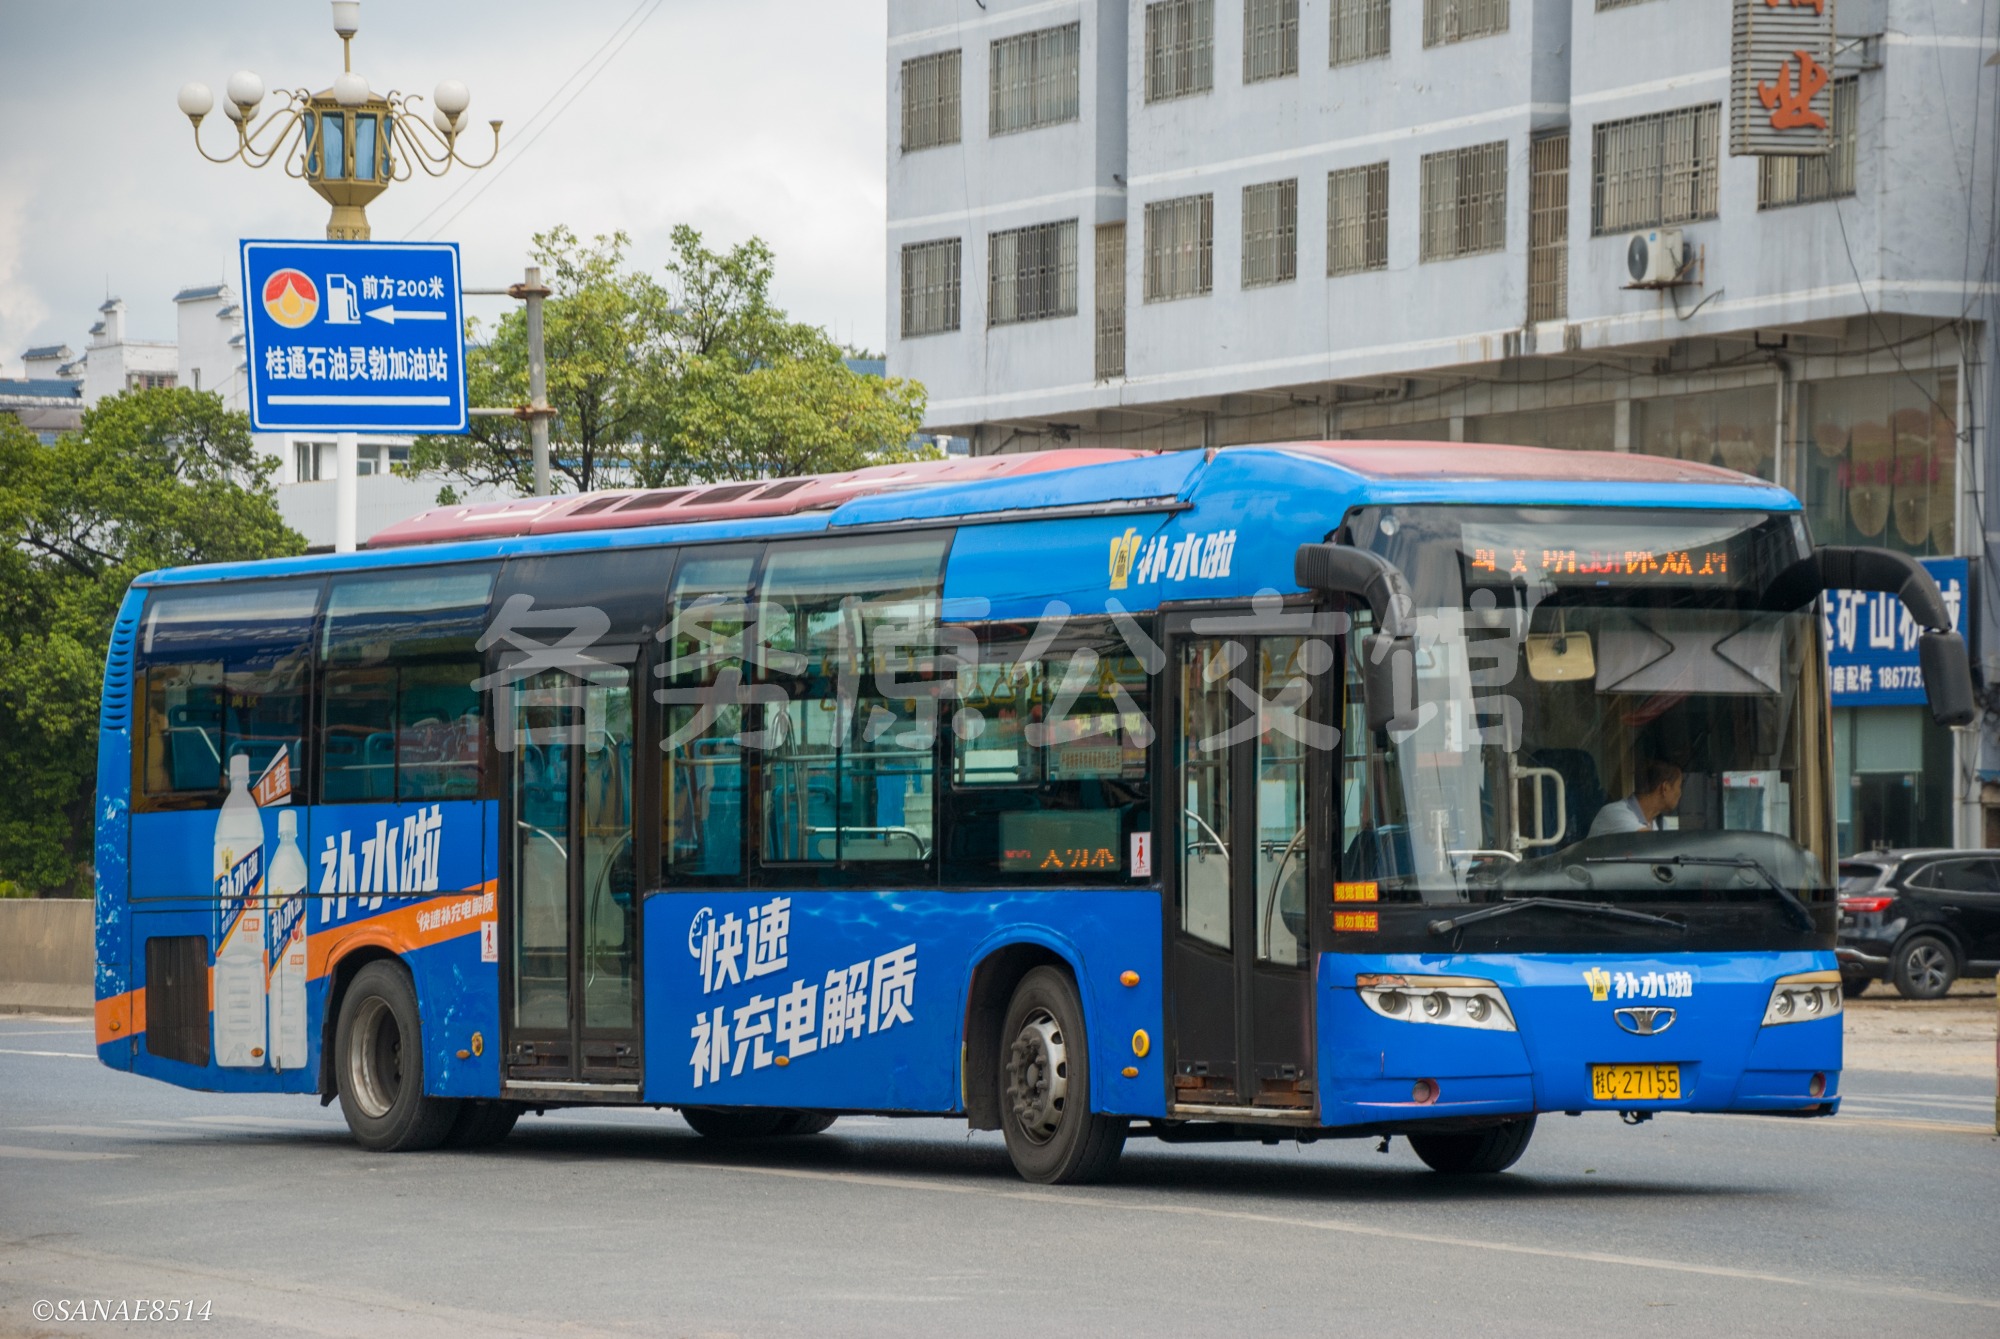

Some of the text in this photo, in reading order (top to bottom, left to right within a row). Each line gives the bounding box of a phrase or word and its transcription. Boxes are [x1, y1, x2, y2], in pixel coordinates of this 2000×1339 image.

[361, 274, 445, 300] 前方200米
[265, 345, 448, 382] 桂通石油灵勃加油站
[1137, 529, 1237, 585] 补水啦
[1829, 664, 1926, 693] 磨配件 186773
[320, 803, 443, 924] 补水啦
[417, 891, 494, 933] 快速补充电解质
[689, 896, 791, 995] 快速
[1613, 970, 1693, 999] 补水啦
[689, 942, 917, 1089] 补充电解质
